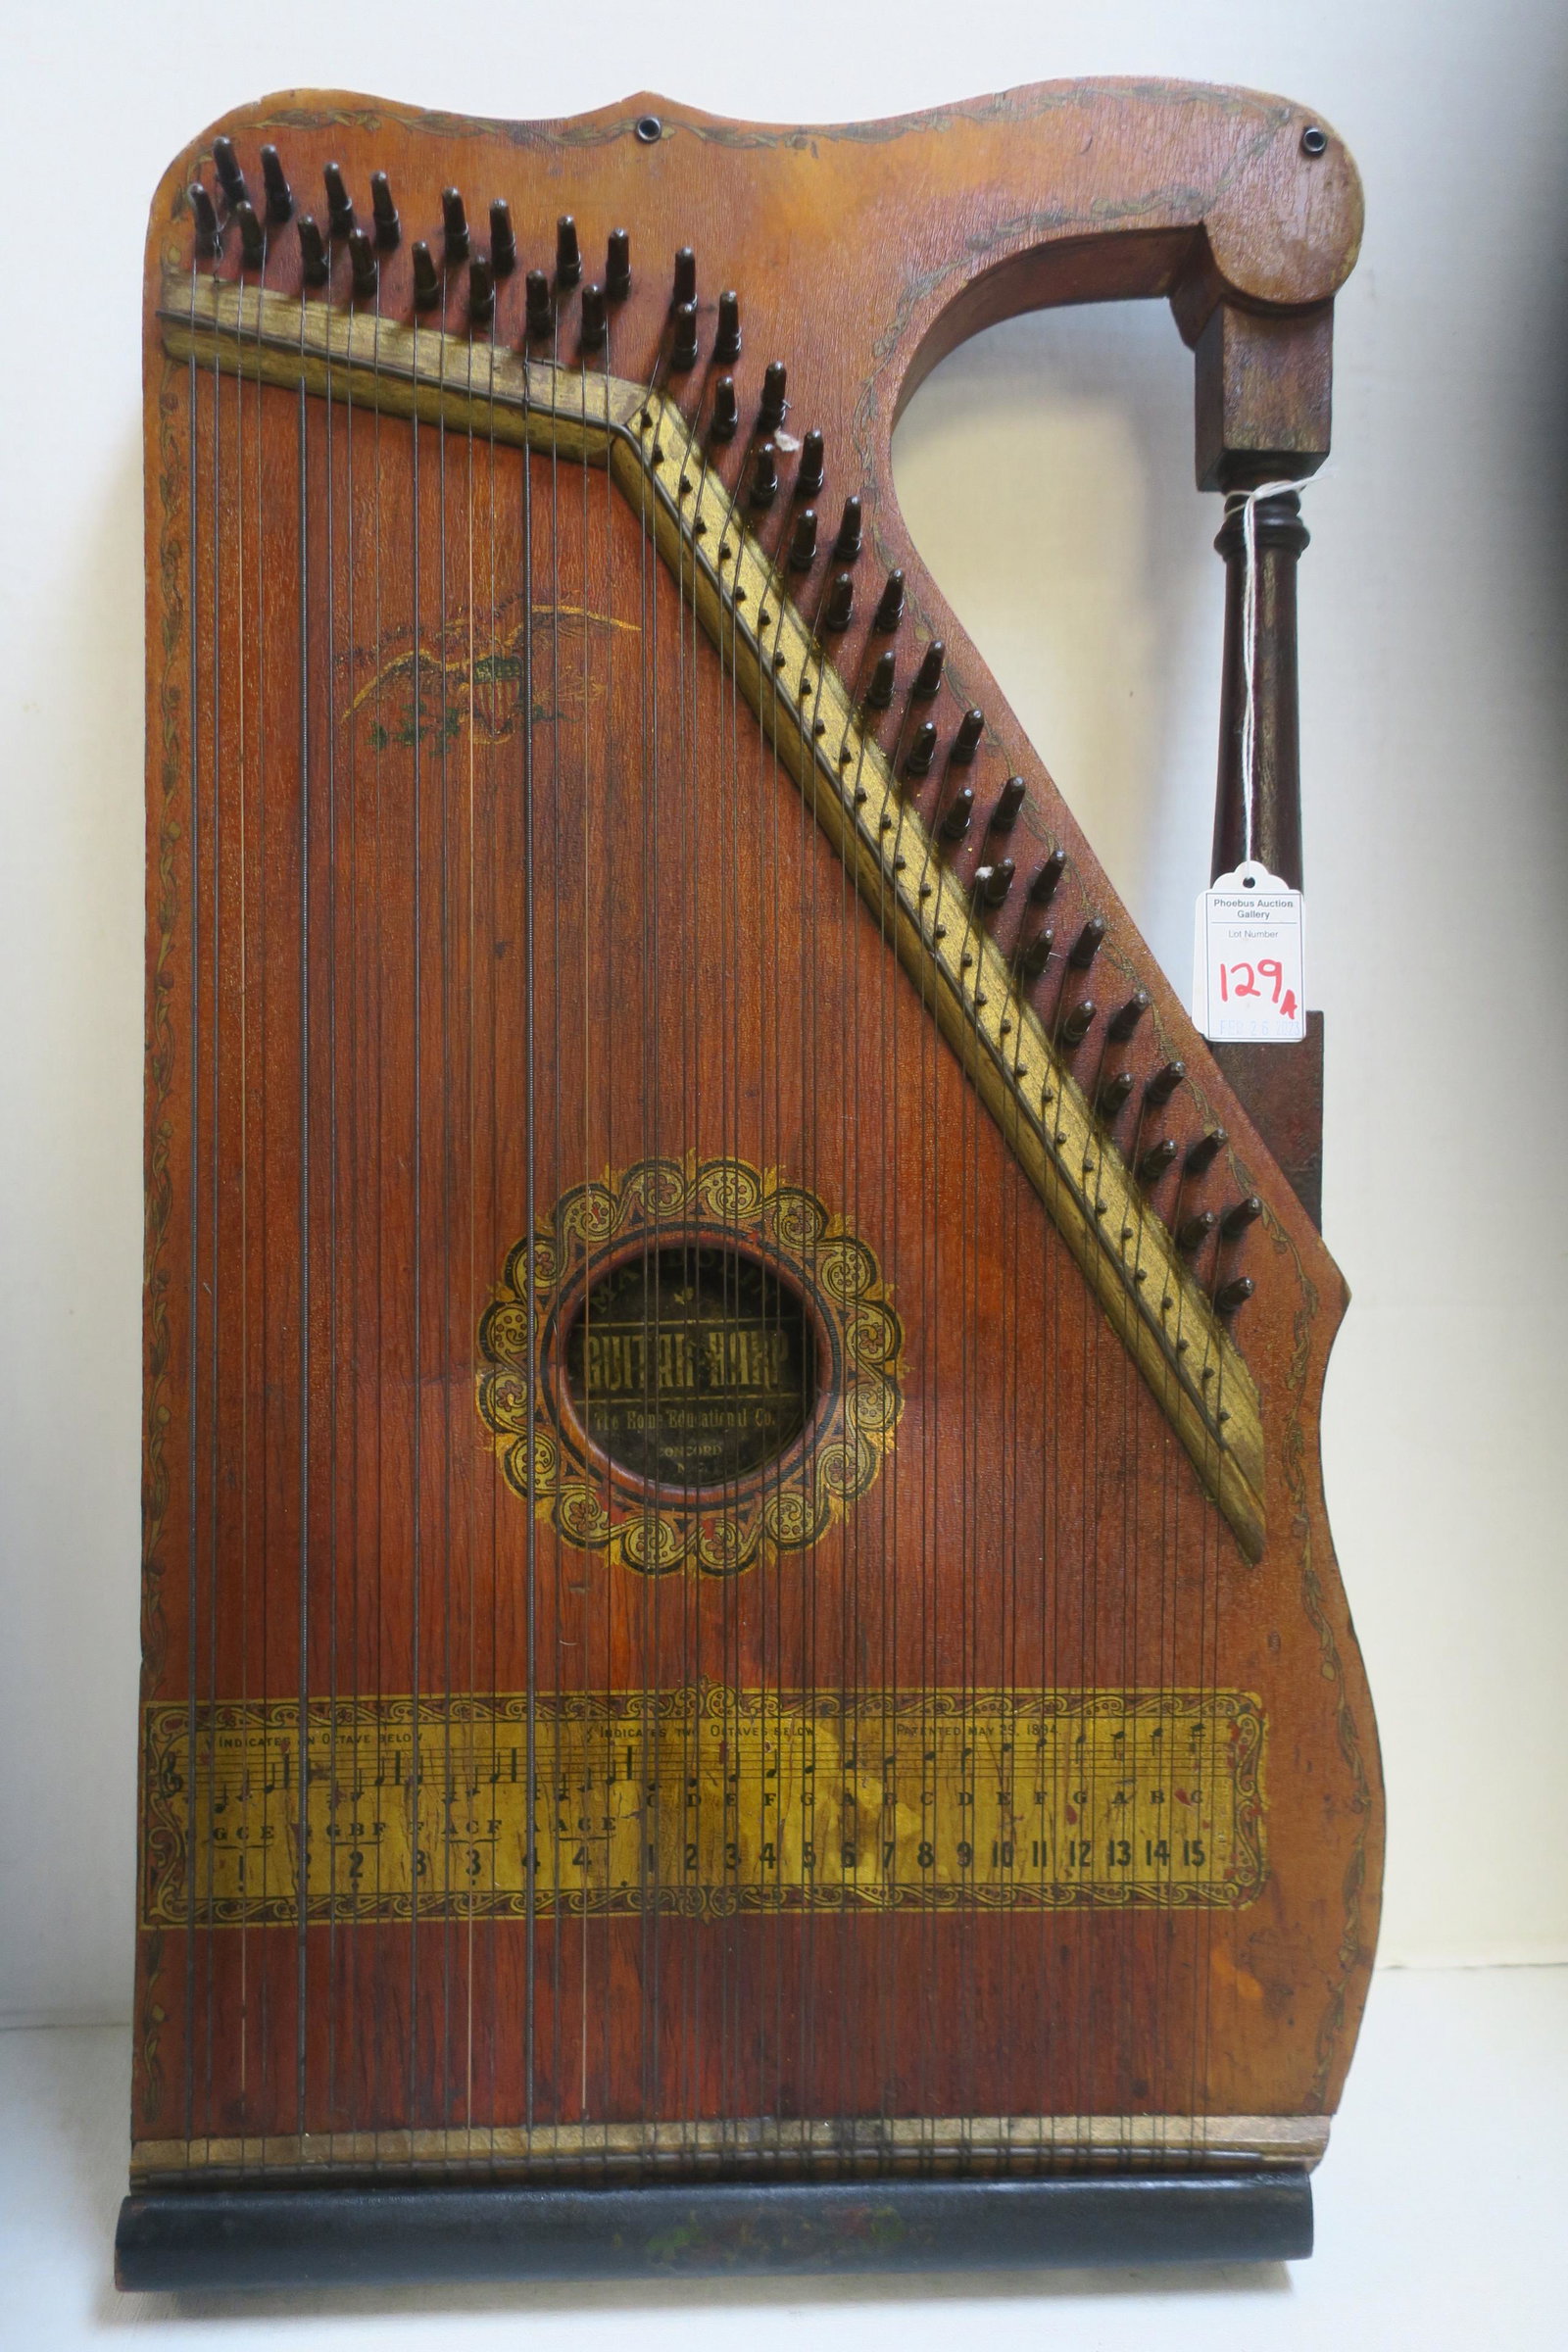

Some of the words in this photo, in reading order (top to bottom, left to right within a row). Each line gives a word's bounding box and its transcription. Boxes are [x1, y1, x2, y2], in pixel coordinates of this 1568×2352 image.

[1213, 899, 1255, 908] Phoebus
[1256, 899, 1294, 908] Auction
[1237, 910, 1271, 920] Gallery
[1228, 930, 1243, 939] Lot
[1244, 930, 1279, 939] Number
[665, 1408, 748, 1429] Eduational
[348, 1851, 365, 1879] 2
[465, 1848, 481, 1876] 3
[571, 1844, 592, 1873] 4
[685, 1842, 699, 1871] 2
[725, 1842, 742, 1870] 3
[760, 1842, 776, 1870] 4
[802, 1841, 817, 1869] 5
[882, 1841, 896, 1869] 7
[917, 1841, 935, 1869] 8
[956, 1840, 973, 1868] 9
[992, 1840, 1014, 1868] 10
[1032, 1840, 1047, 1868] 11
[1069, 1839, 1092, 1867] 12
[1108, 1839, 1132, 1867] 13
[1146, 1839, 1170, 1867] 14
[1183, 1838, 1205, 1867] 15
